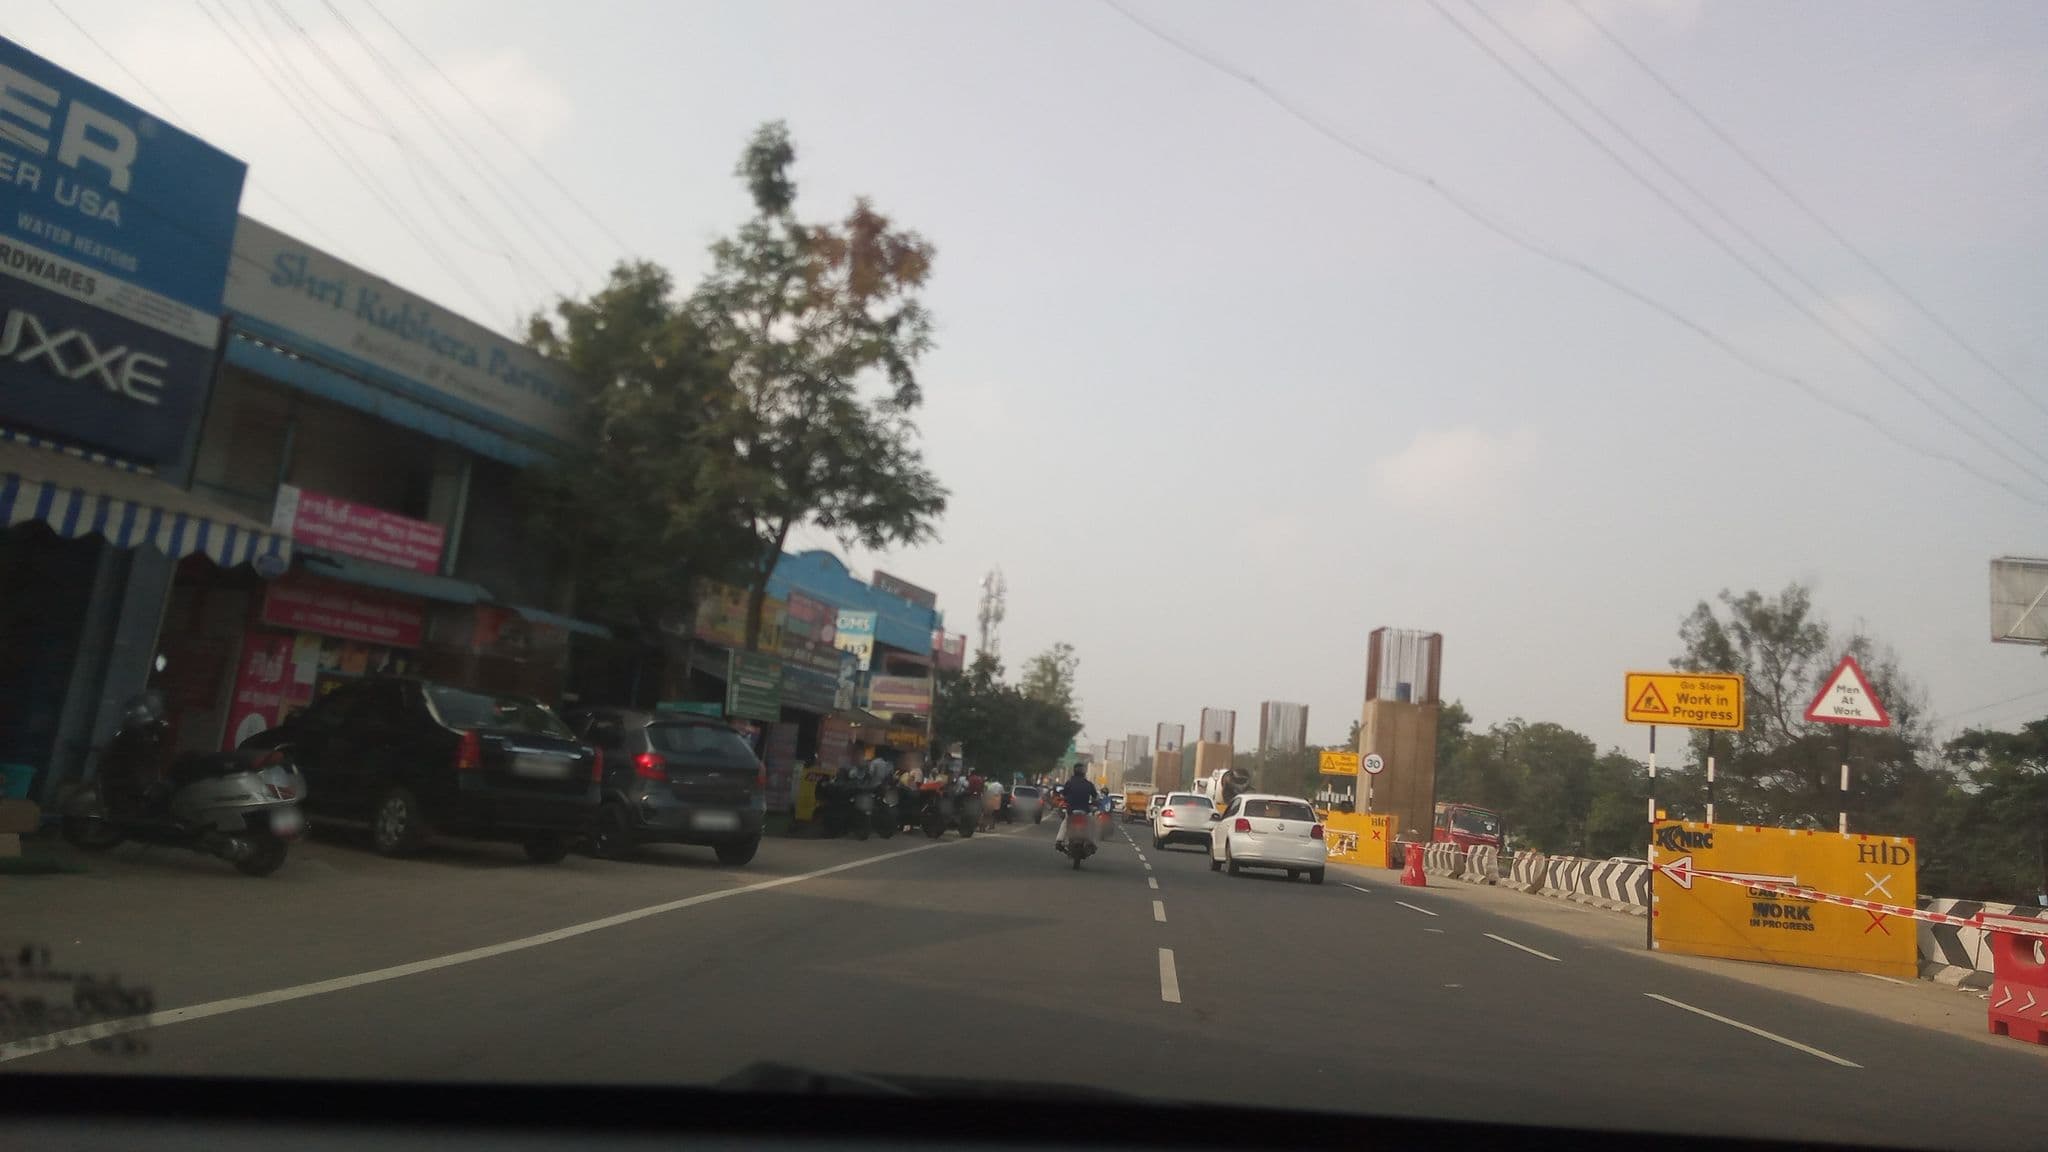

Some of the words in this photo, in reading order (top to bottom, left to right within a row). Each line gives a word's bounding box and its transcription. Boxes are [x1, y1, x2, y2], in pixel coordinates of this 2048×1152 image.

[54, 175, 121, 228] USA
[17, 209, 71, 247] WATER
[270, 251, 347, 309] Shri
[1680, 681, 1695, 691] Go
[1699, 682, 1725, 692] Slow
[1836, 684, 1860, 695] Men
[1676, 693, 1712, 706] Work
[1716, 694, 1729, 707] in
[1841, 696, 1854, 705] At
[1672, 707, 1733, 722] Progress
[1833, 705, 1862, 717] Work
[1366, 759, 1381, 770] 30
[1753, 902, 1812, 921] WORK
[1750, 919, 1761, 928] IN
[1763, 919, 1815, 932] PROGRESS
